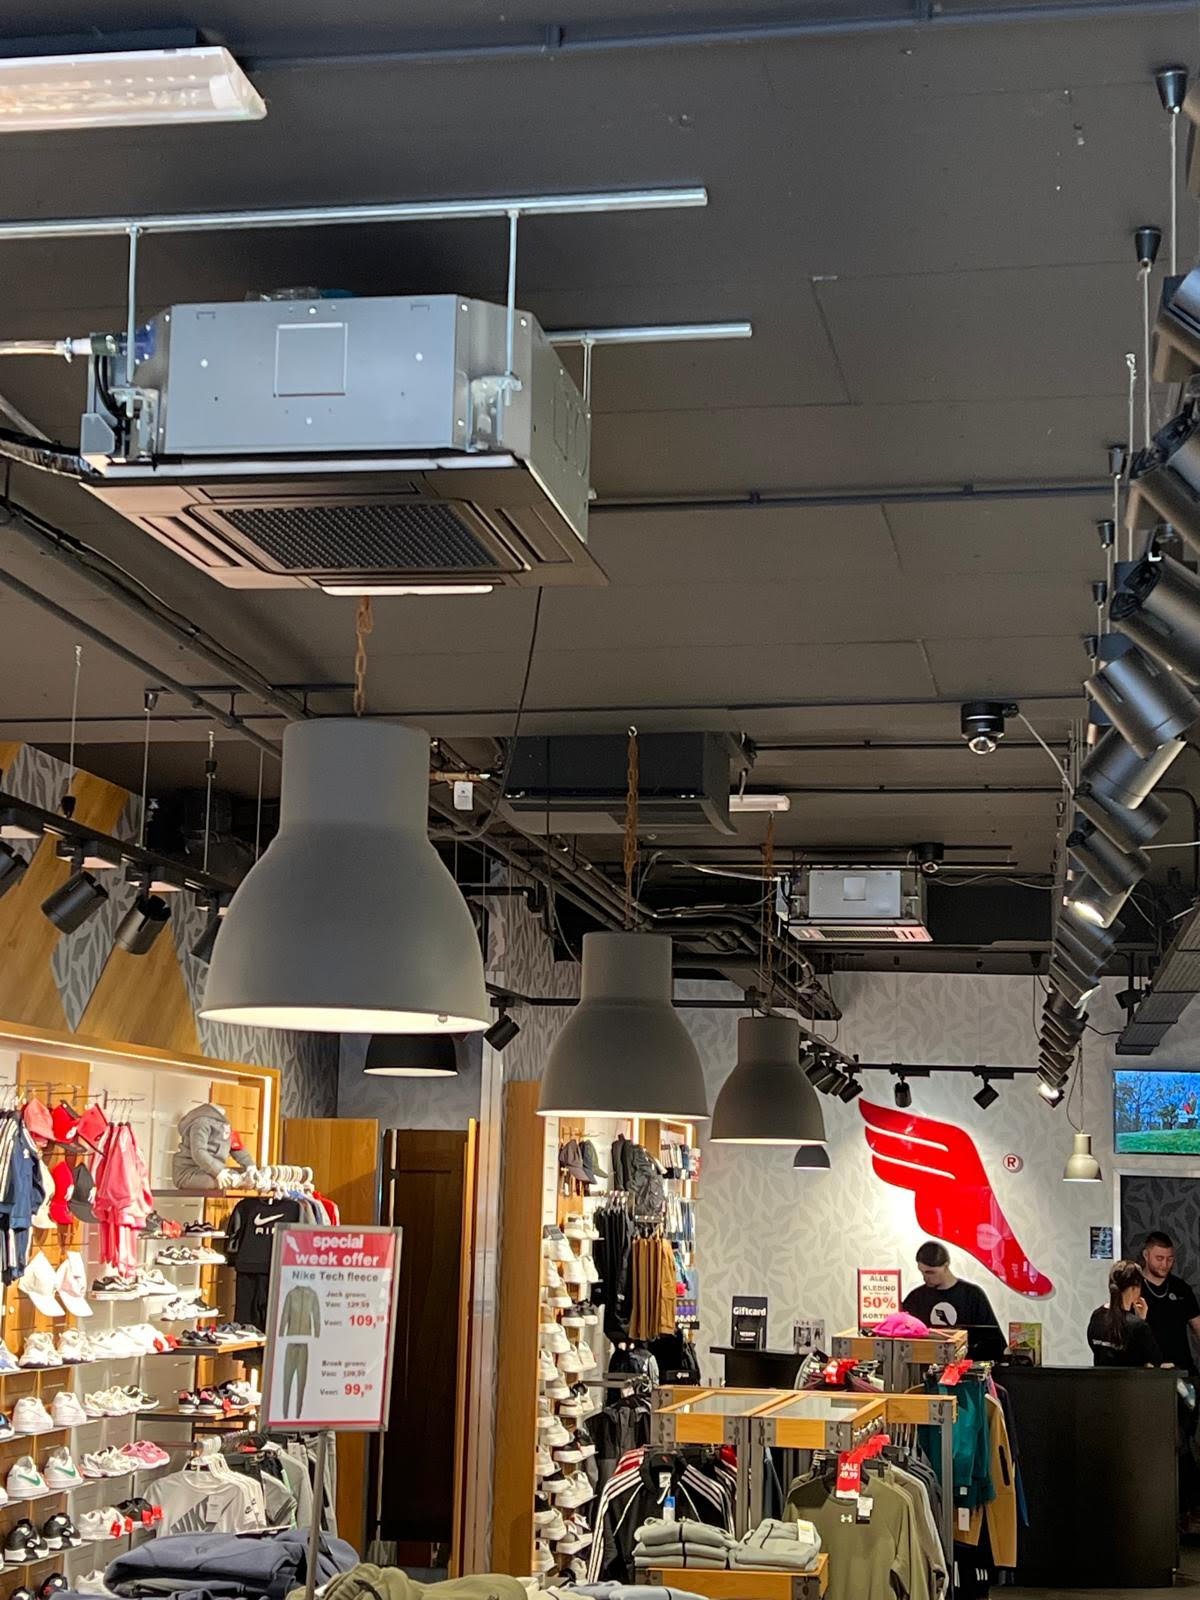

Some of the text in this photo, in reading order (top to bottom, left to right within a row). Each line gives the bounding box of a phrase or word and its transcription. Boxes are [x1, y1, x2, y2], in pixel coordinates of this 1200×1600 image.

[313, 1234, 364, 1250] special
[296, 1252, 379, 1266] week offer
[292, 1271, 378, 1282] Nike Tech fleece
[863, 1297, 897, 1309] 50%
[733, 1306, 767, 1317] Giftcard
[840, 1462, 859, 1471] SALE
